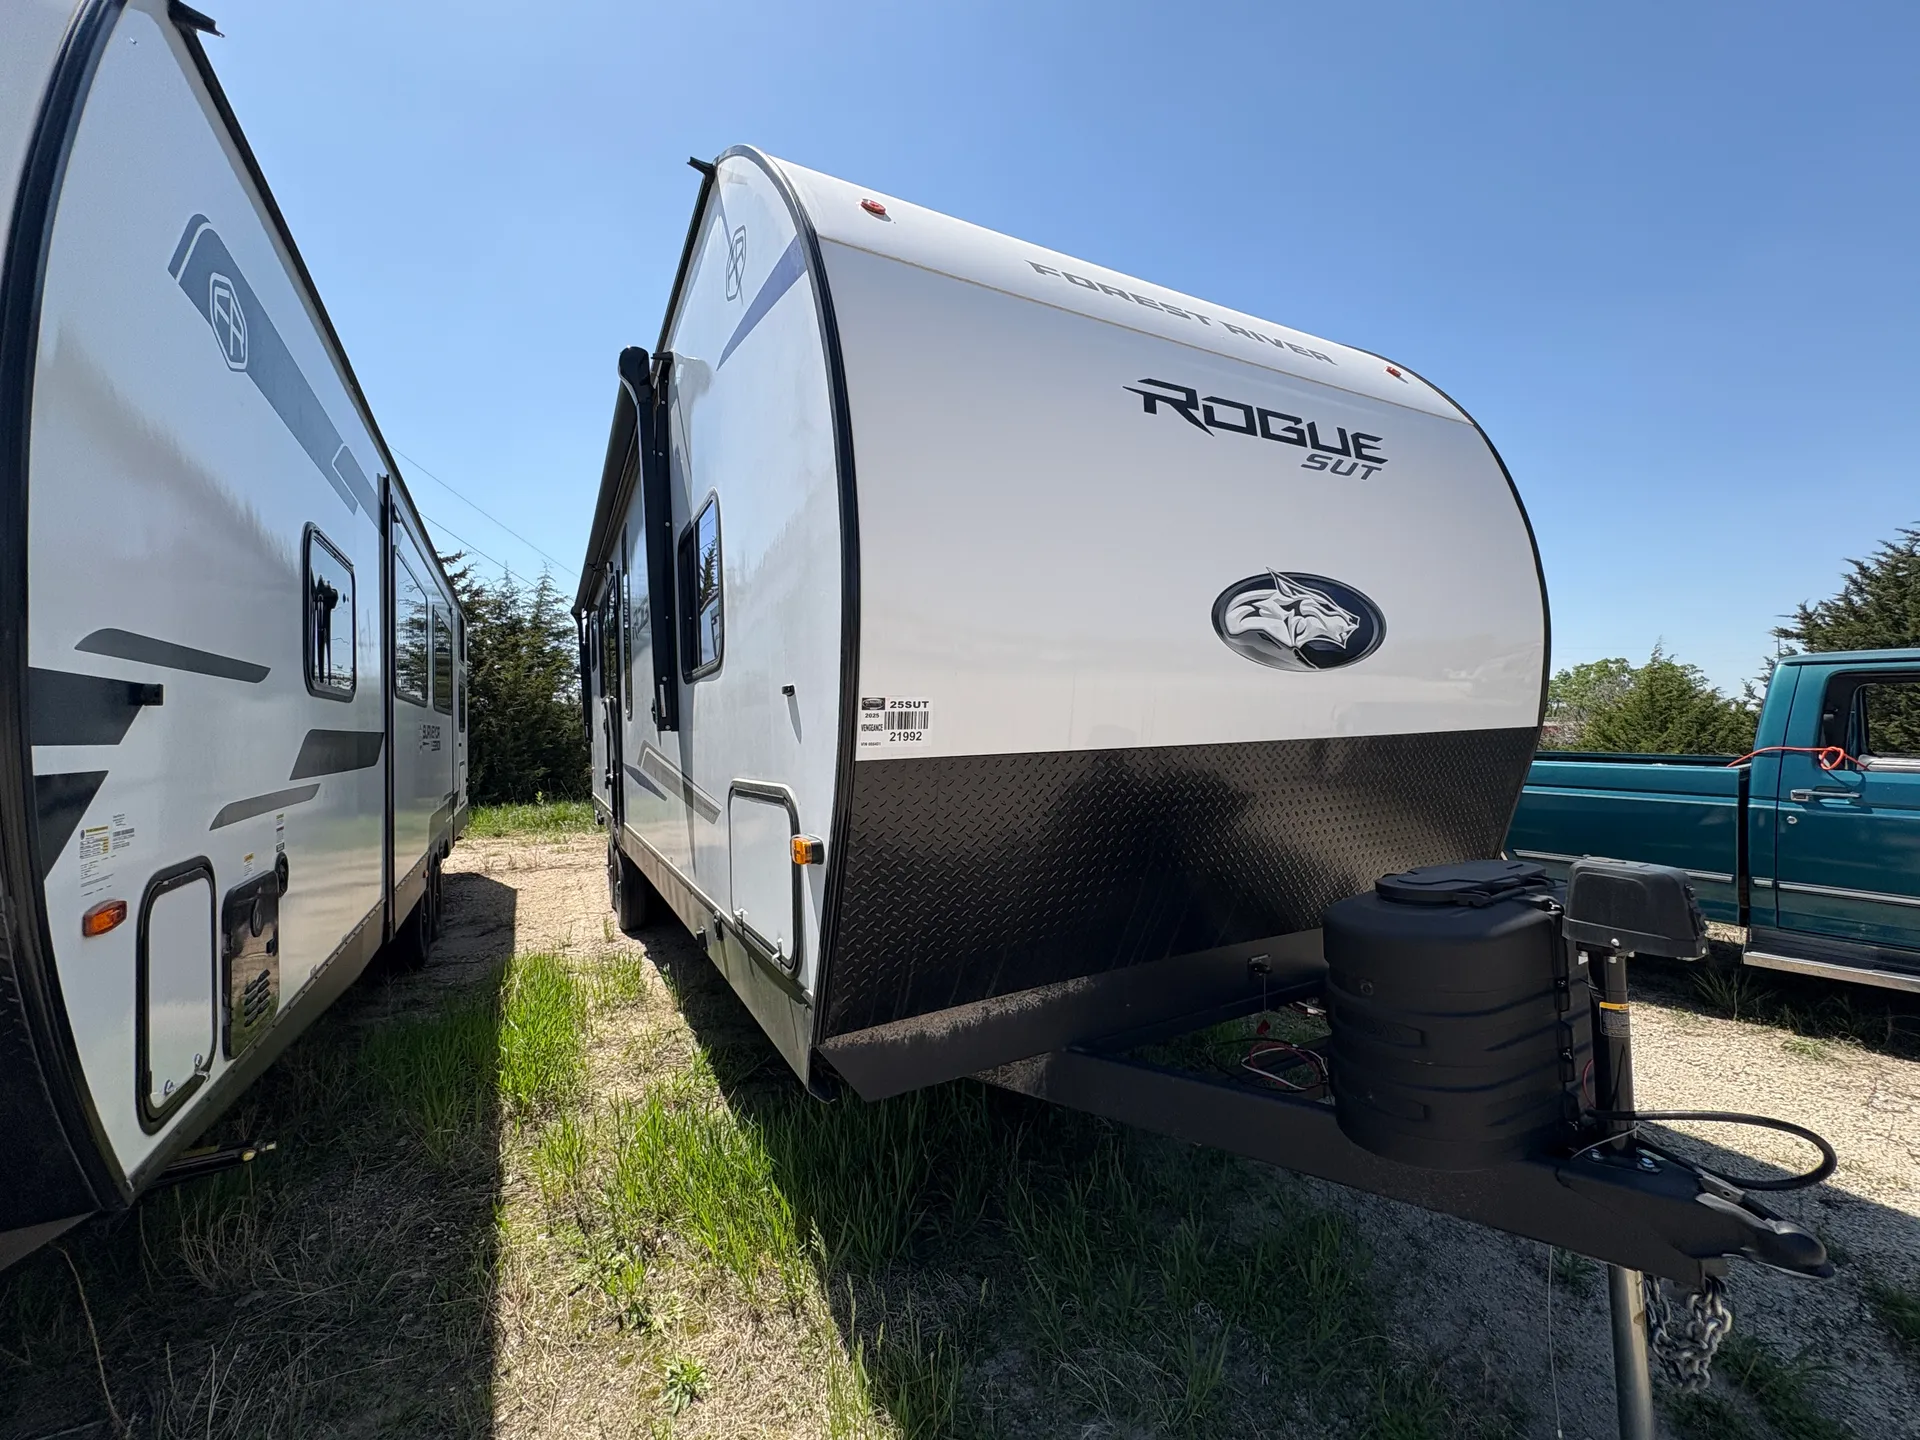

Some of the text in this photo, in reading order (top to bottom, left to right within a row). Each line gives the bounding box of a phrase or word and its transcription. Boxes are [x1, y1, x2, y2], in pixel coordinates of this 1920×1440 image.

[1024, 260, 1338, 366] FOREST RIVER
[1122, 378, 1389, 465] ROGUE
[1301, 454, 1383, 481] SUT
[889, 700, 930, 709] 25SUT
[860, 723, 884, 732] VENGEANCE
[889, 731, 923, 742] 21992
